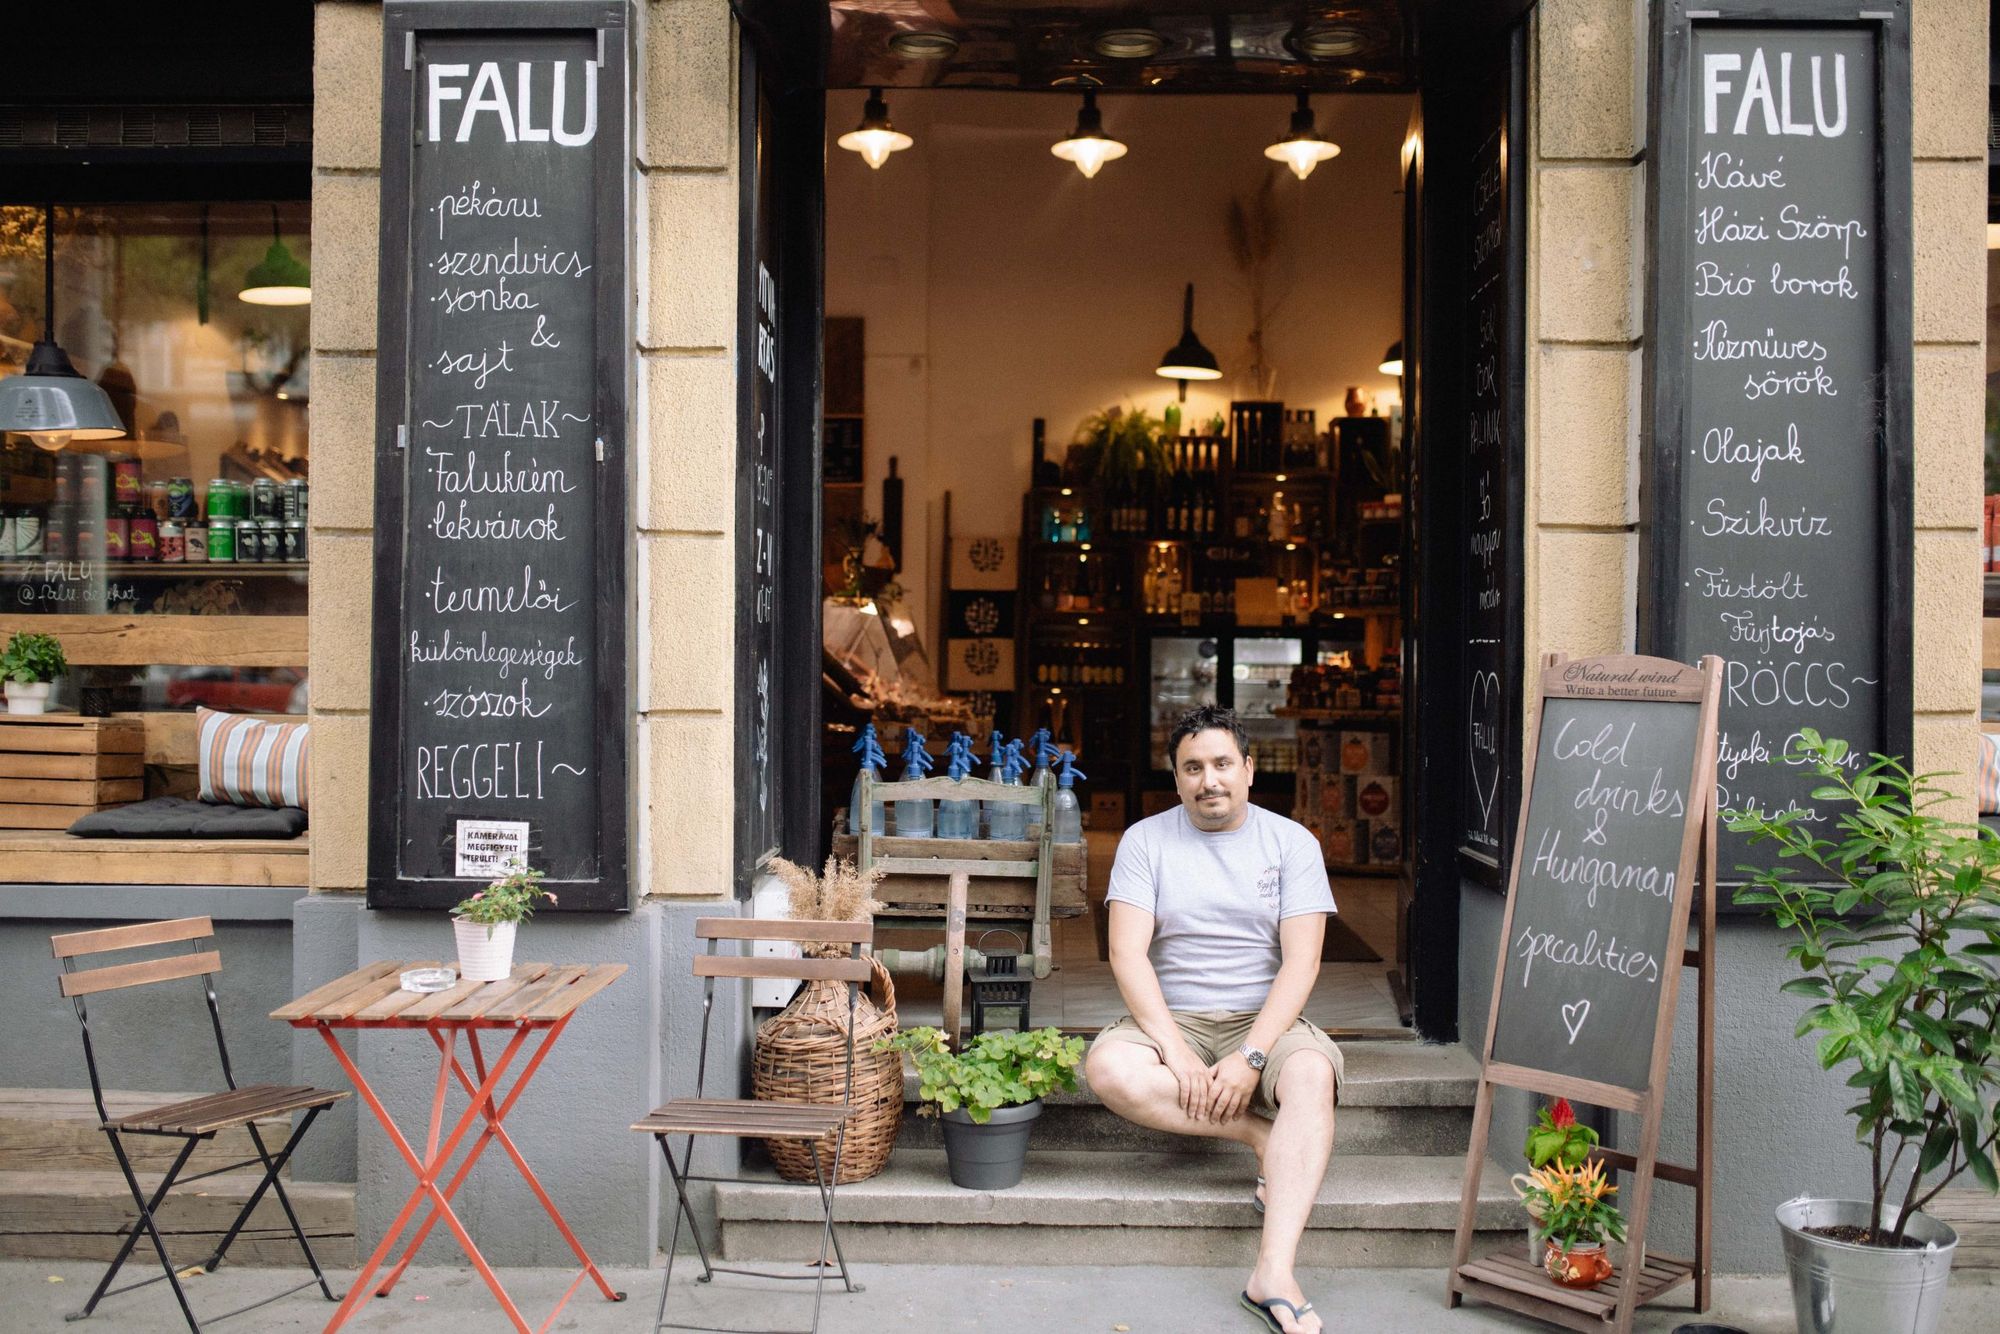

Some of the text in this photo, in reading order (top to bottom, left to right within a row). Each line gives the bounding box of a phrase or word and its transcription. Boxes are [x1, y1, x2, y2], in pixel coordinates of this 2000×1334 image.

[428, 60, 597, 146] FALU
[1704, 47, 1847, 137] FALU
[1698, 151, 1786, 189] Kávé
[1697, 204, 1867, 259] Házi Szörp
[438, 237, 592, 278] szendvics
[1771, 262, 1858, 299] borok
[531, 315, 560, 348] &
[437, 340, 514, 390] sajt
[1703, 423, 1805, 483] Olajak
[433, 499, 567, 541] lekvárok
[1563, 663, 1639, 683] Natural
[1565, 685, 1598, 696] Write
[1608, 686, 1640, 697] better
[1643, 687, 1678, 698] future
[1698, 660, 1850, 709] RÖCCS
[1553, 718, 1636, 767] Cold
[1716, 730, 1771, 779] tyeki
[417, 740, 544, 800] REGGELI
[1574, 768, 1684, 817] drinks
[1582, 808, 1607, 845] &
